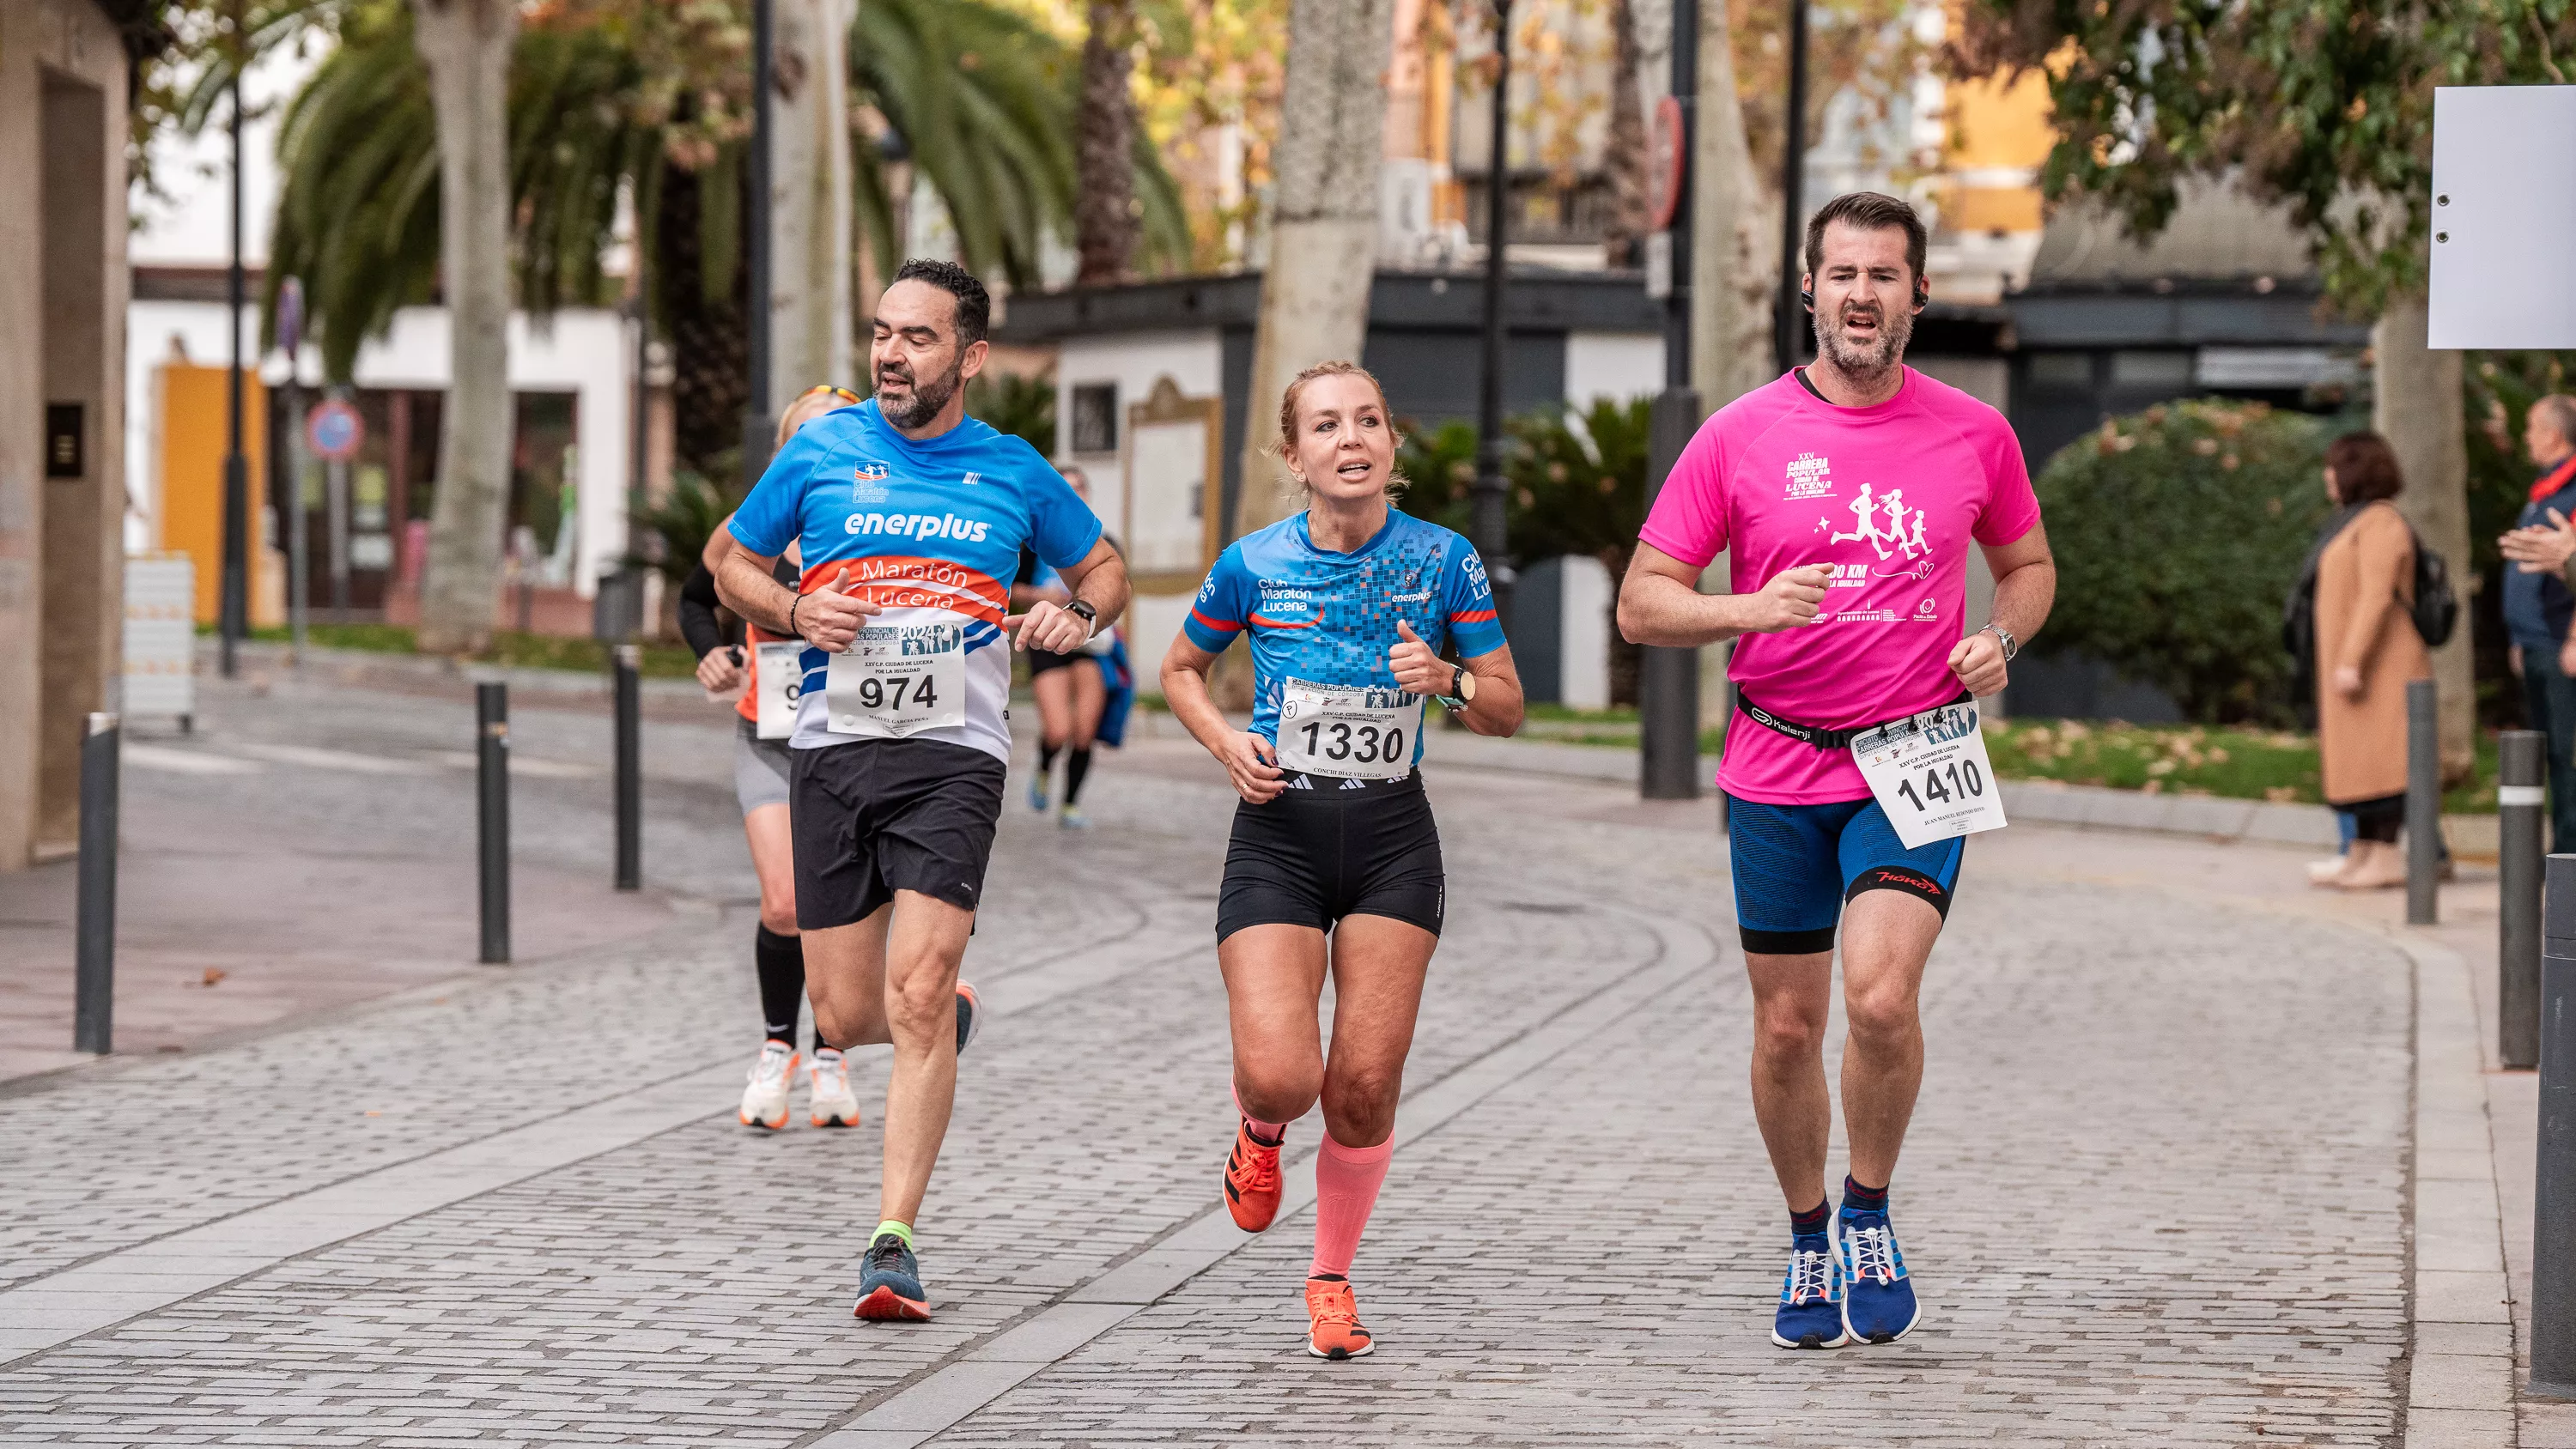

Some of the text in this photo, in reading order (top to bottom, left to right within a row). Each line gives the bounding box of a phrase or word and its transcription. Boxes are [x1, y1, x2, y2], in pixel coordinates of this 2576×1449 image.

[1798, 452, 1814, 460] XXV
[1787, 458, 1828, 472] CARRERA
[1786, 468, 1831, 478] POPULAR
[1785, 481, 1832, 492] LUCENA
[853, 495, 885, 504] Lucena
[844, 513, 988, 543] enerplus
[1461, 548, 1481, 573] Clu
[860, 560, 968, 588] Maratón
[1847, 565, 1868, 579] KM
[1258, 579, 1288, 589] Club
[866, 587, 954, 609] Lucena
[1261, 587, 1312, 600] Maratón
[1392, 591, 1431, 603] enerplus
[1262, 600, 1308, 613] Lucena
[902, 626, 935, 640] 2024
[1291, 677, 1326, 690] CARRERAS
[860, 675, 938, 712] 974
[868, 714, 891, 724] MANUEL
[1773, 719, 1811, 740] Kalenji
[1301, 721, 1403, 764] 1330
[1855, 735, 1879, 748] CIRCUITO
[1856, 739, 1887, 755] CARRERAS
[1920, 751, 1938, 761] CIUDAD
[1898, 759, 1982, 812] 1410
[1937, 812, 1956, 822] MANUEL
